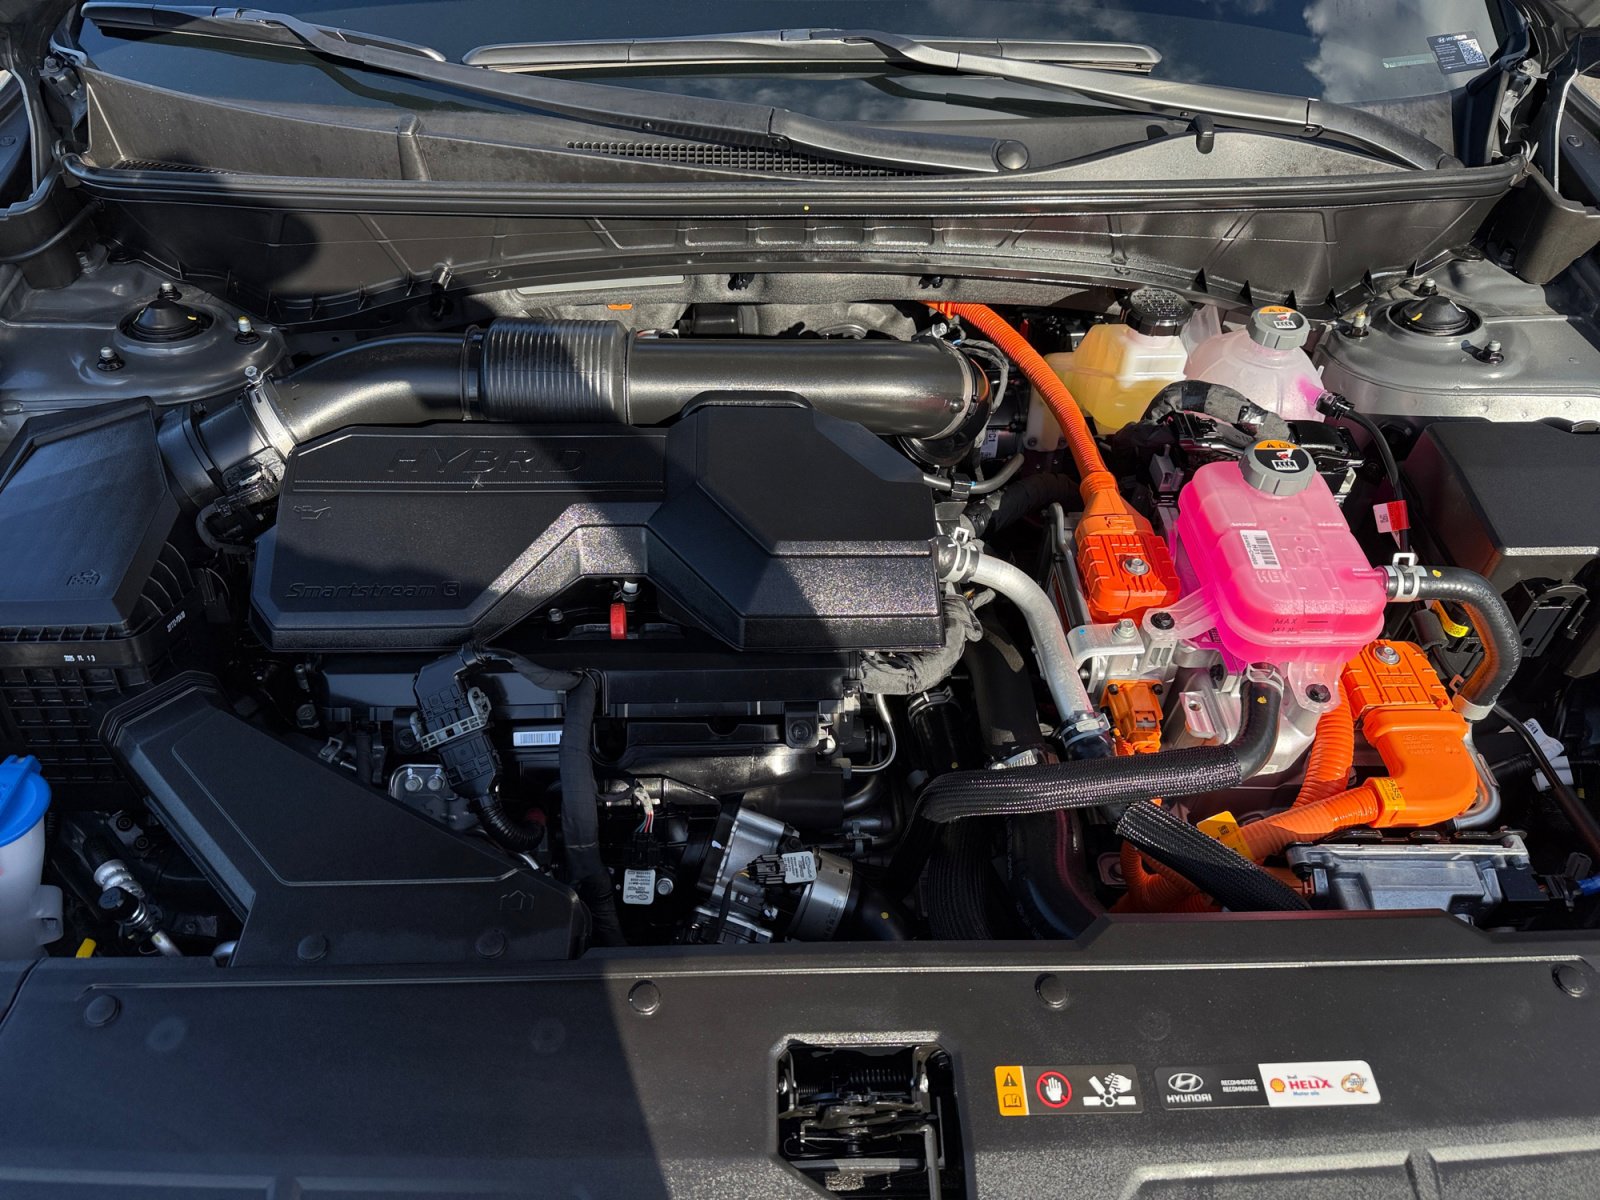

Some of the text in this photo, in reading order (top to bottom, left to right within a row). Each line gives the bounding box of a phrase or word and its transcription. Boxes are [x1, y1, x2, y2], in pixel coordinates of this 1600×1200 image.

[384, 447, 585, 474] HYBRID
[284, 579, 462, 600] Smartstream G
[1288, 1078, 1334, 1090] HELIX
[1166, 1093, 1213, 1103] HYUNDAI
